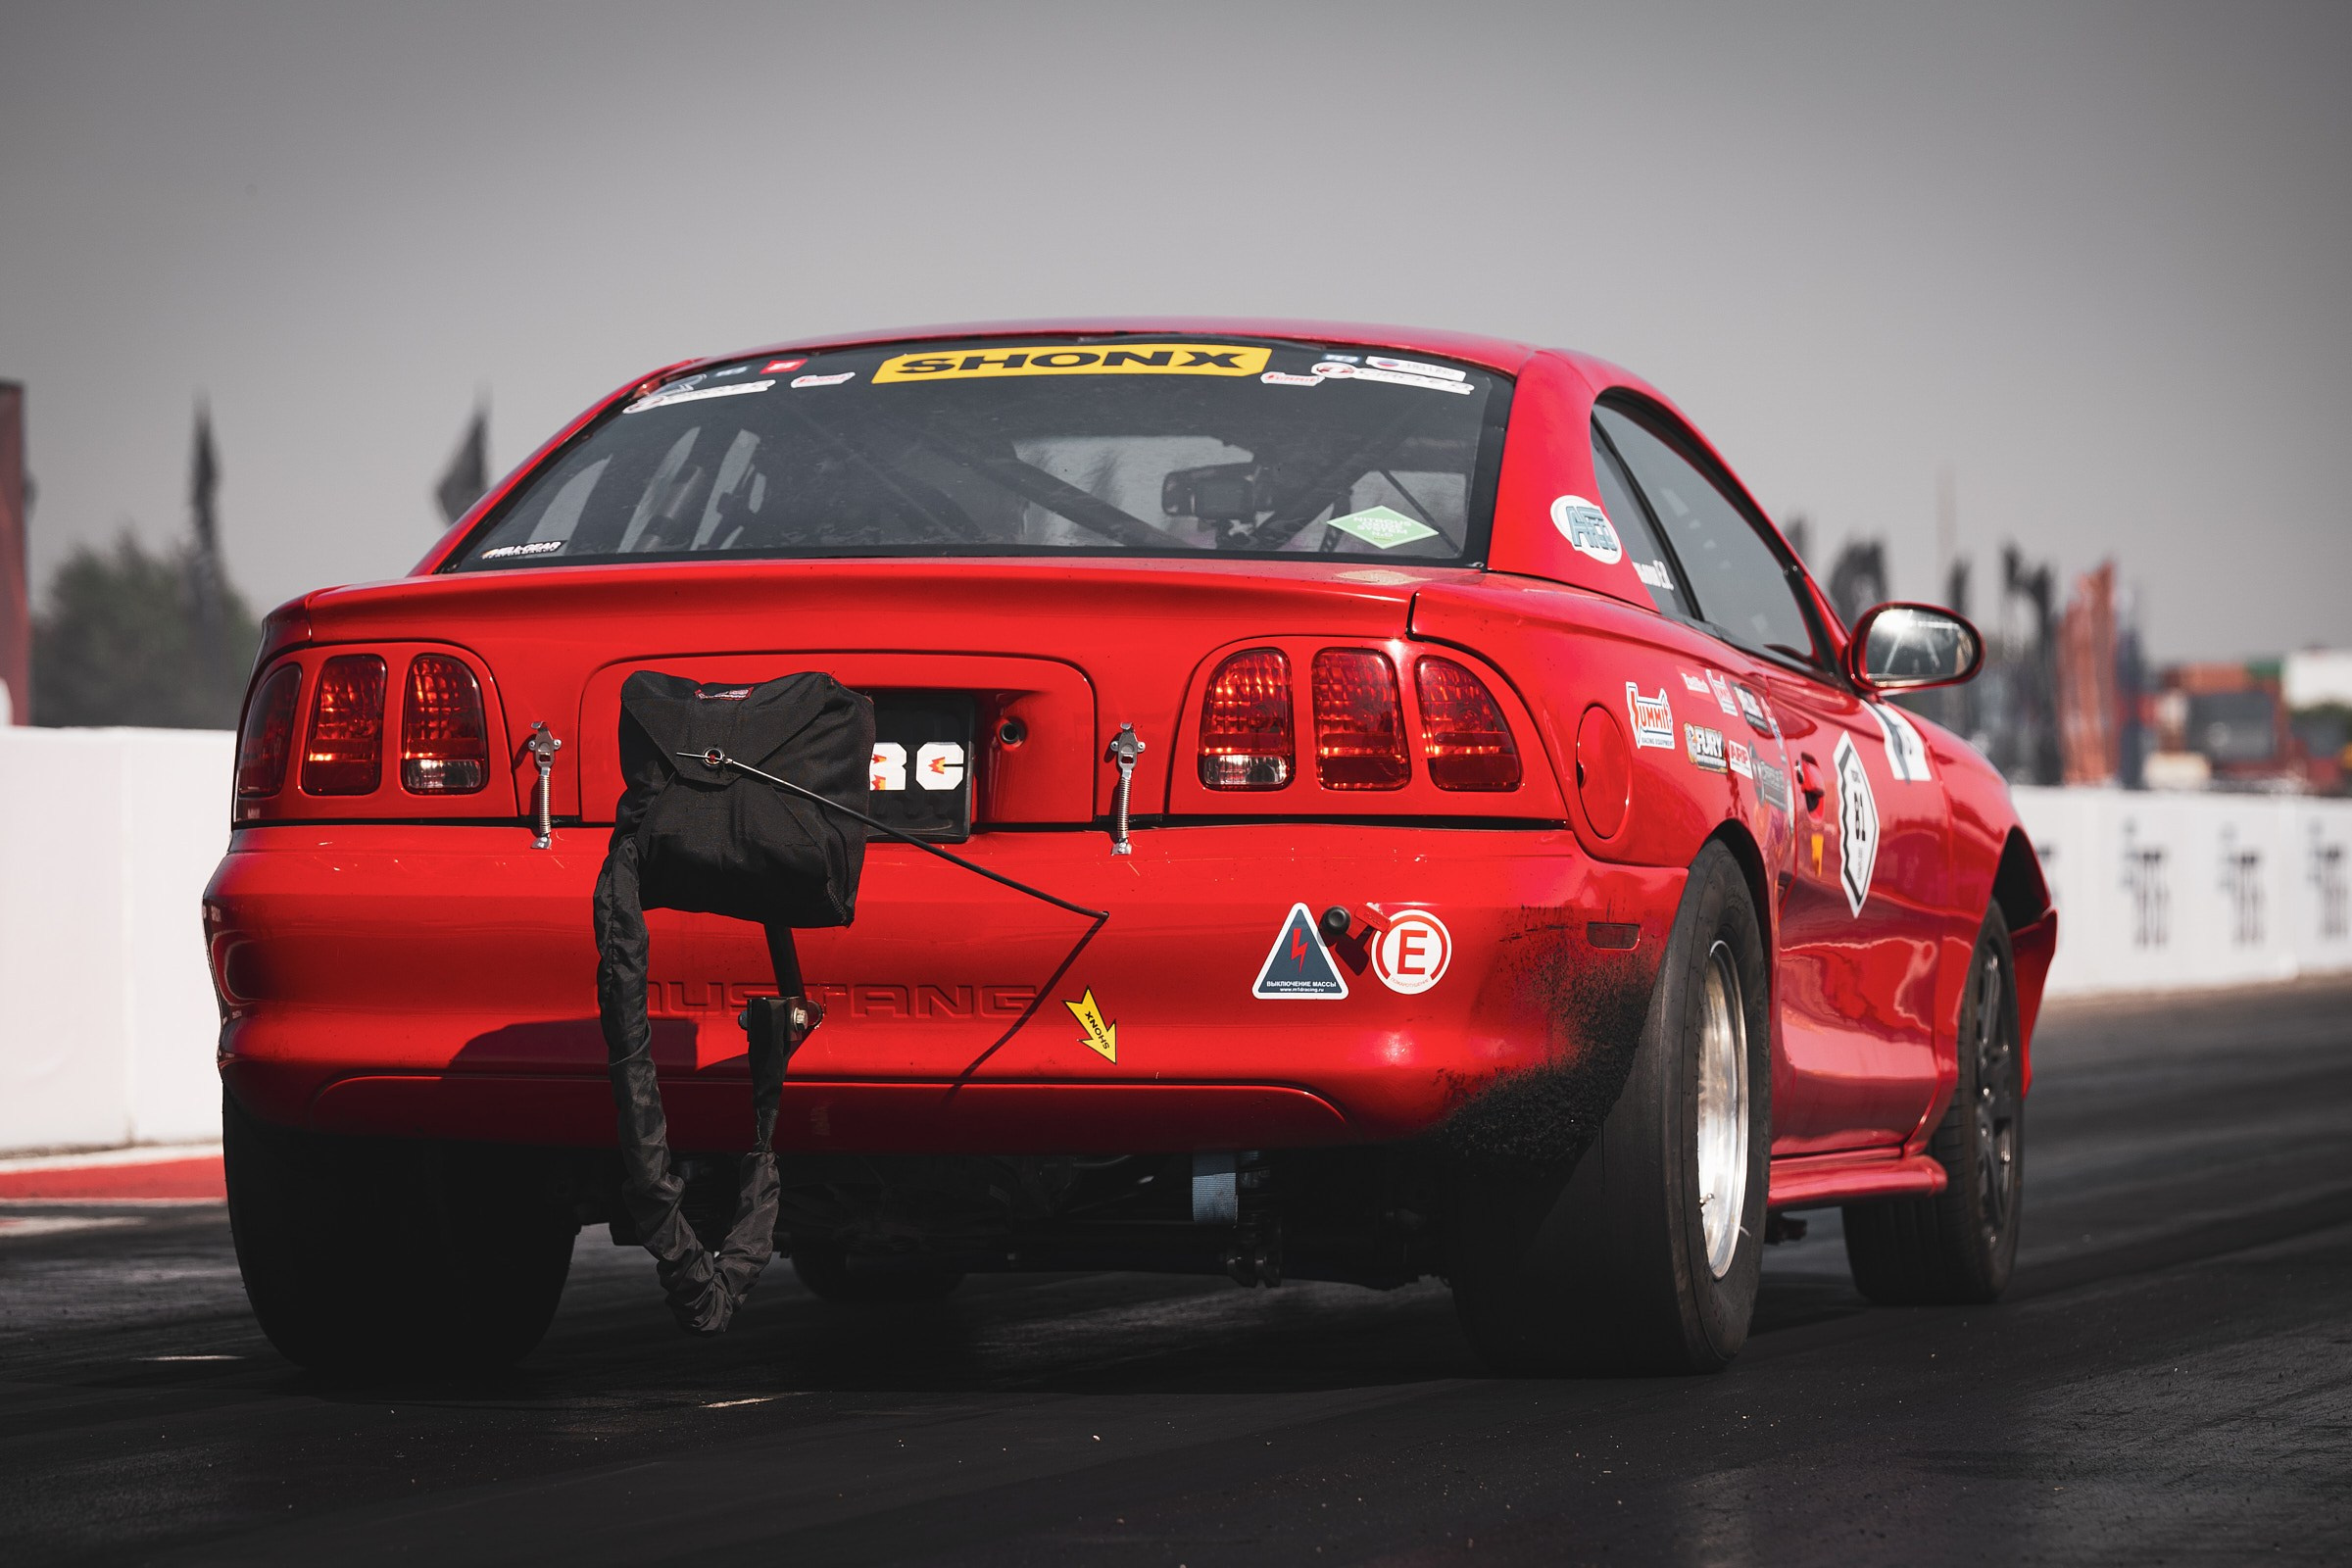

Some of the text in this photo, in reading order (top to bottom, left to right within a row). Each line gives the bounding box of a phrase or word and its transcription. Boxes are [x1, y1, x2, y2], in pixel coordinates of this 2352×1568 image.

[895, 350, 1249, 374] SHONX
[1630, 690, 1671, 730] SUMMIT
[1731, 744, 1748, 765] ARP
[1396, 928, 1428, 974] E
[647, 980, 1039, 1020] USTANG
[1085, 1010, 1110, 1050] SHONX
